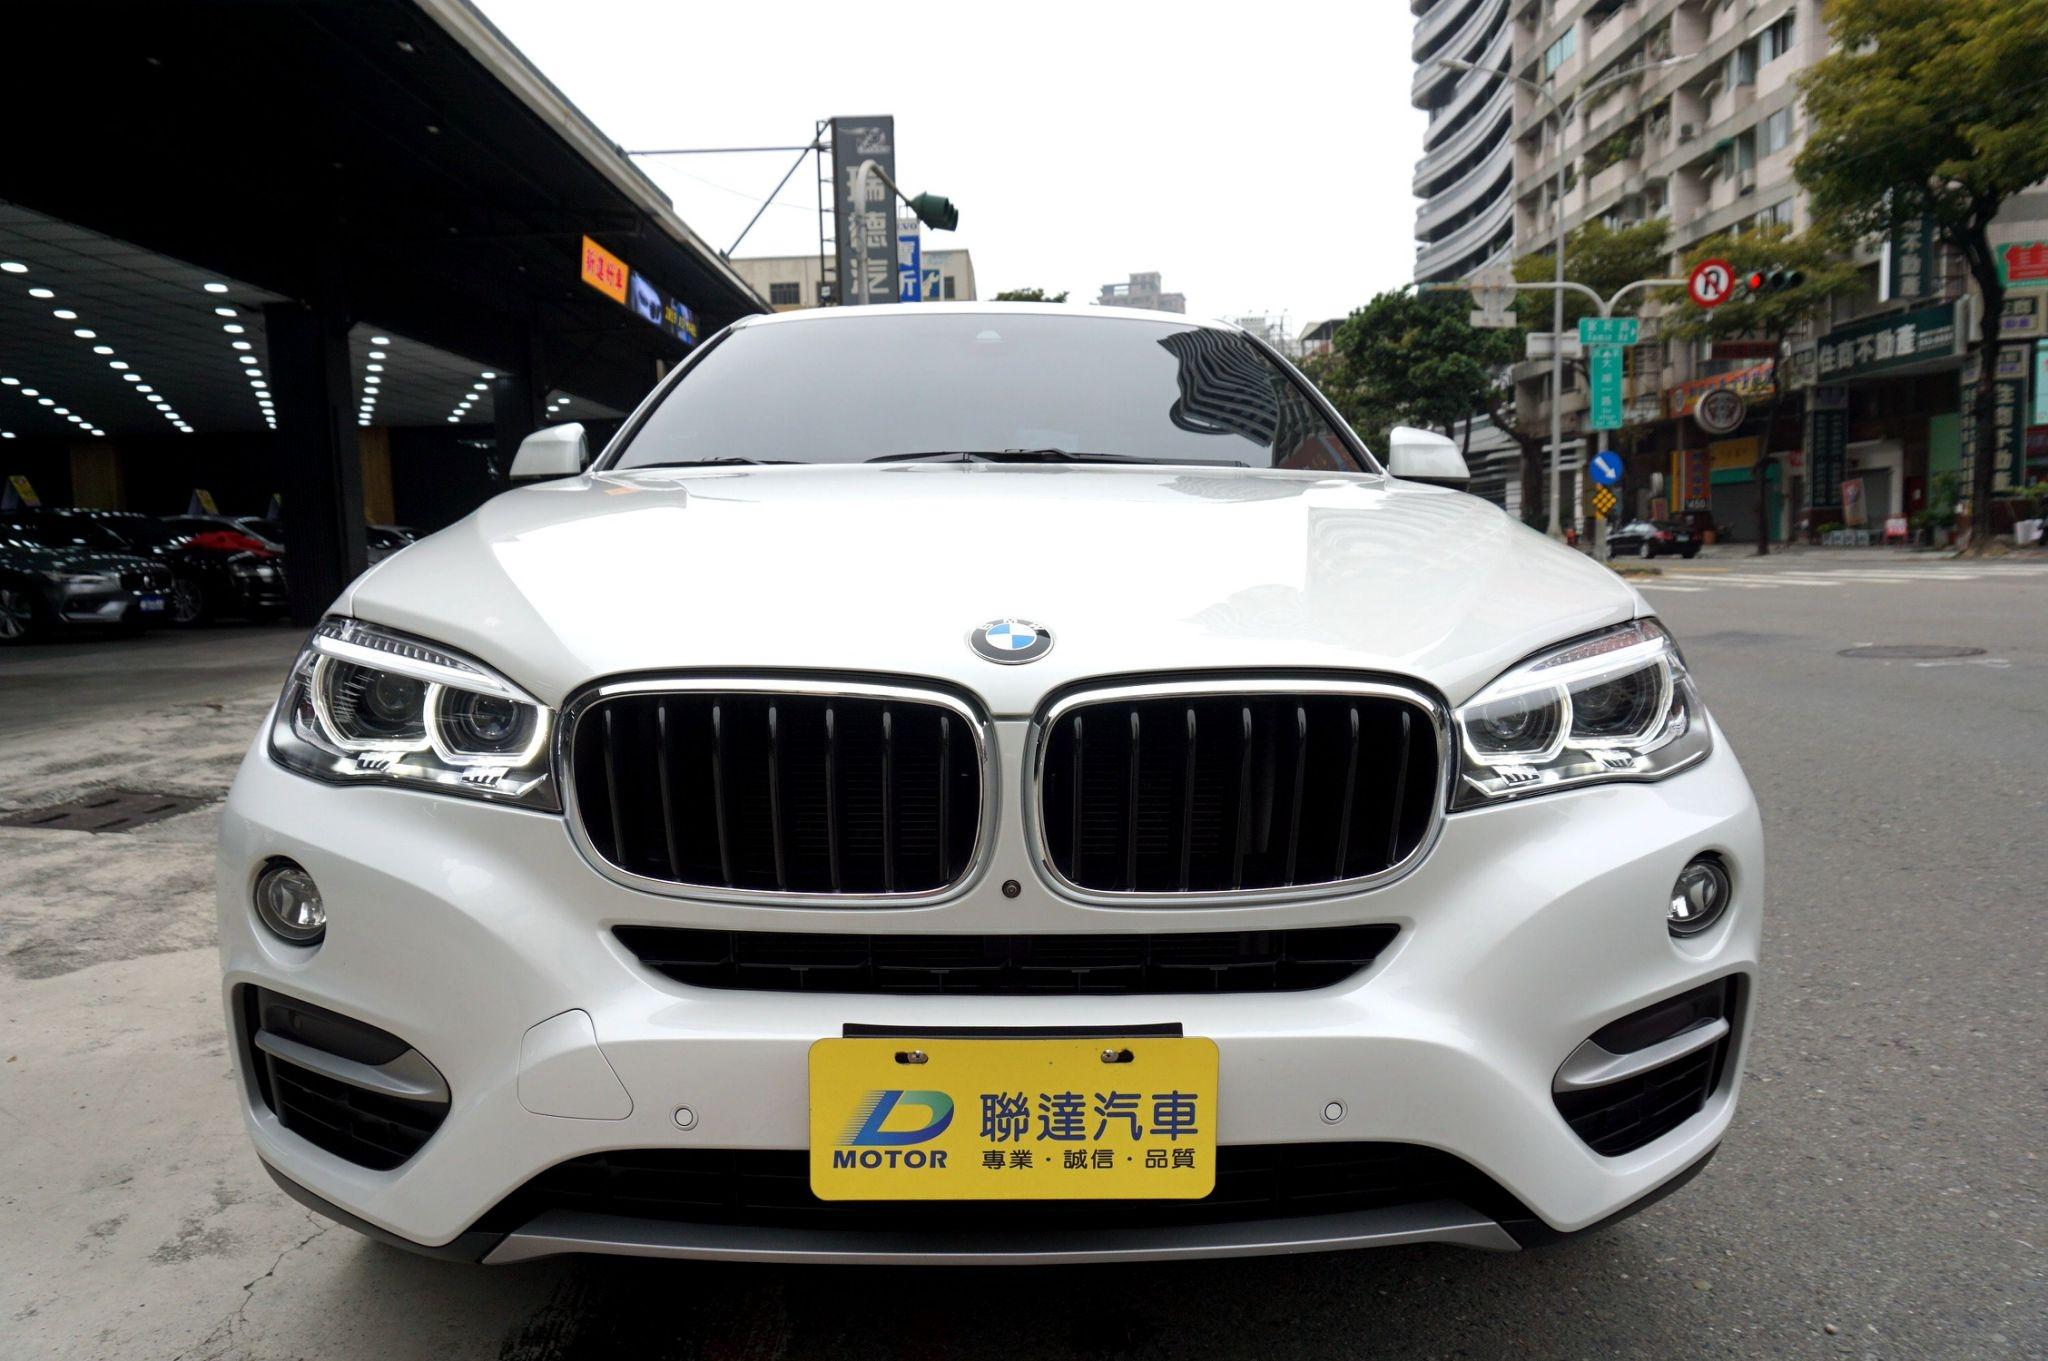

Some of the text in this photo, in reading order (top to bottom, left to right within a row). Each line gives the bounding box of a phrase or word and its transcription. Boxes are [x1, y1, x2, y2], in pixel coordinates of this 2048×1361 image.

[980, 1090, 1198, 1142] 聯達汽車
[833, 1150, 948, 1169] MOTOR
